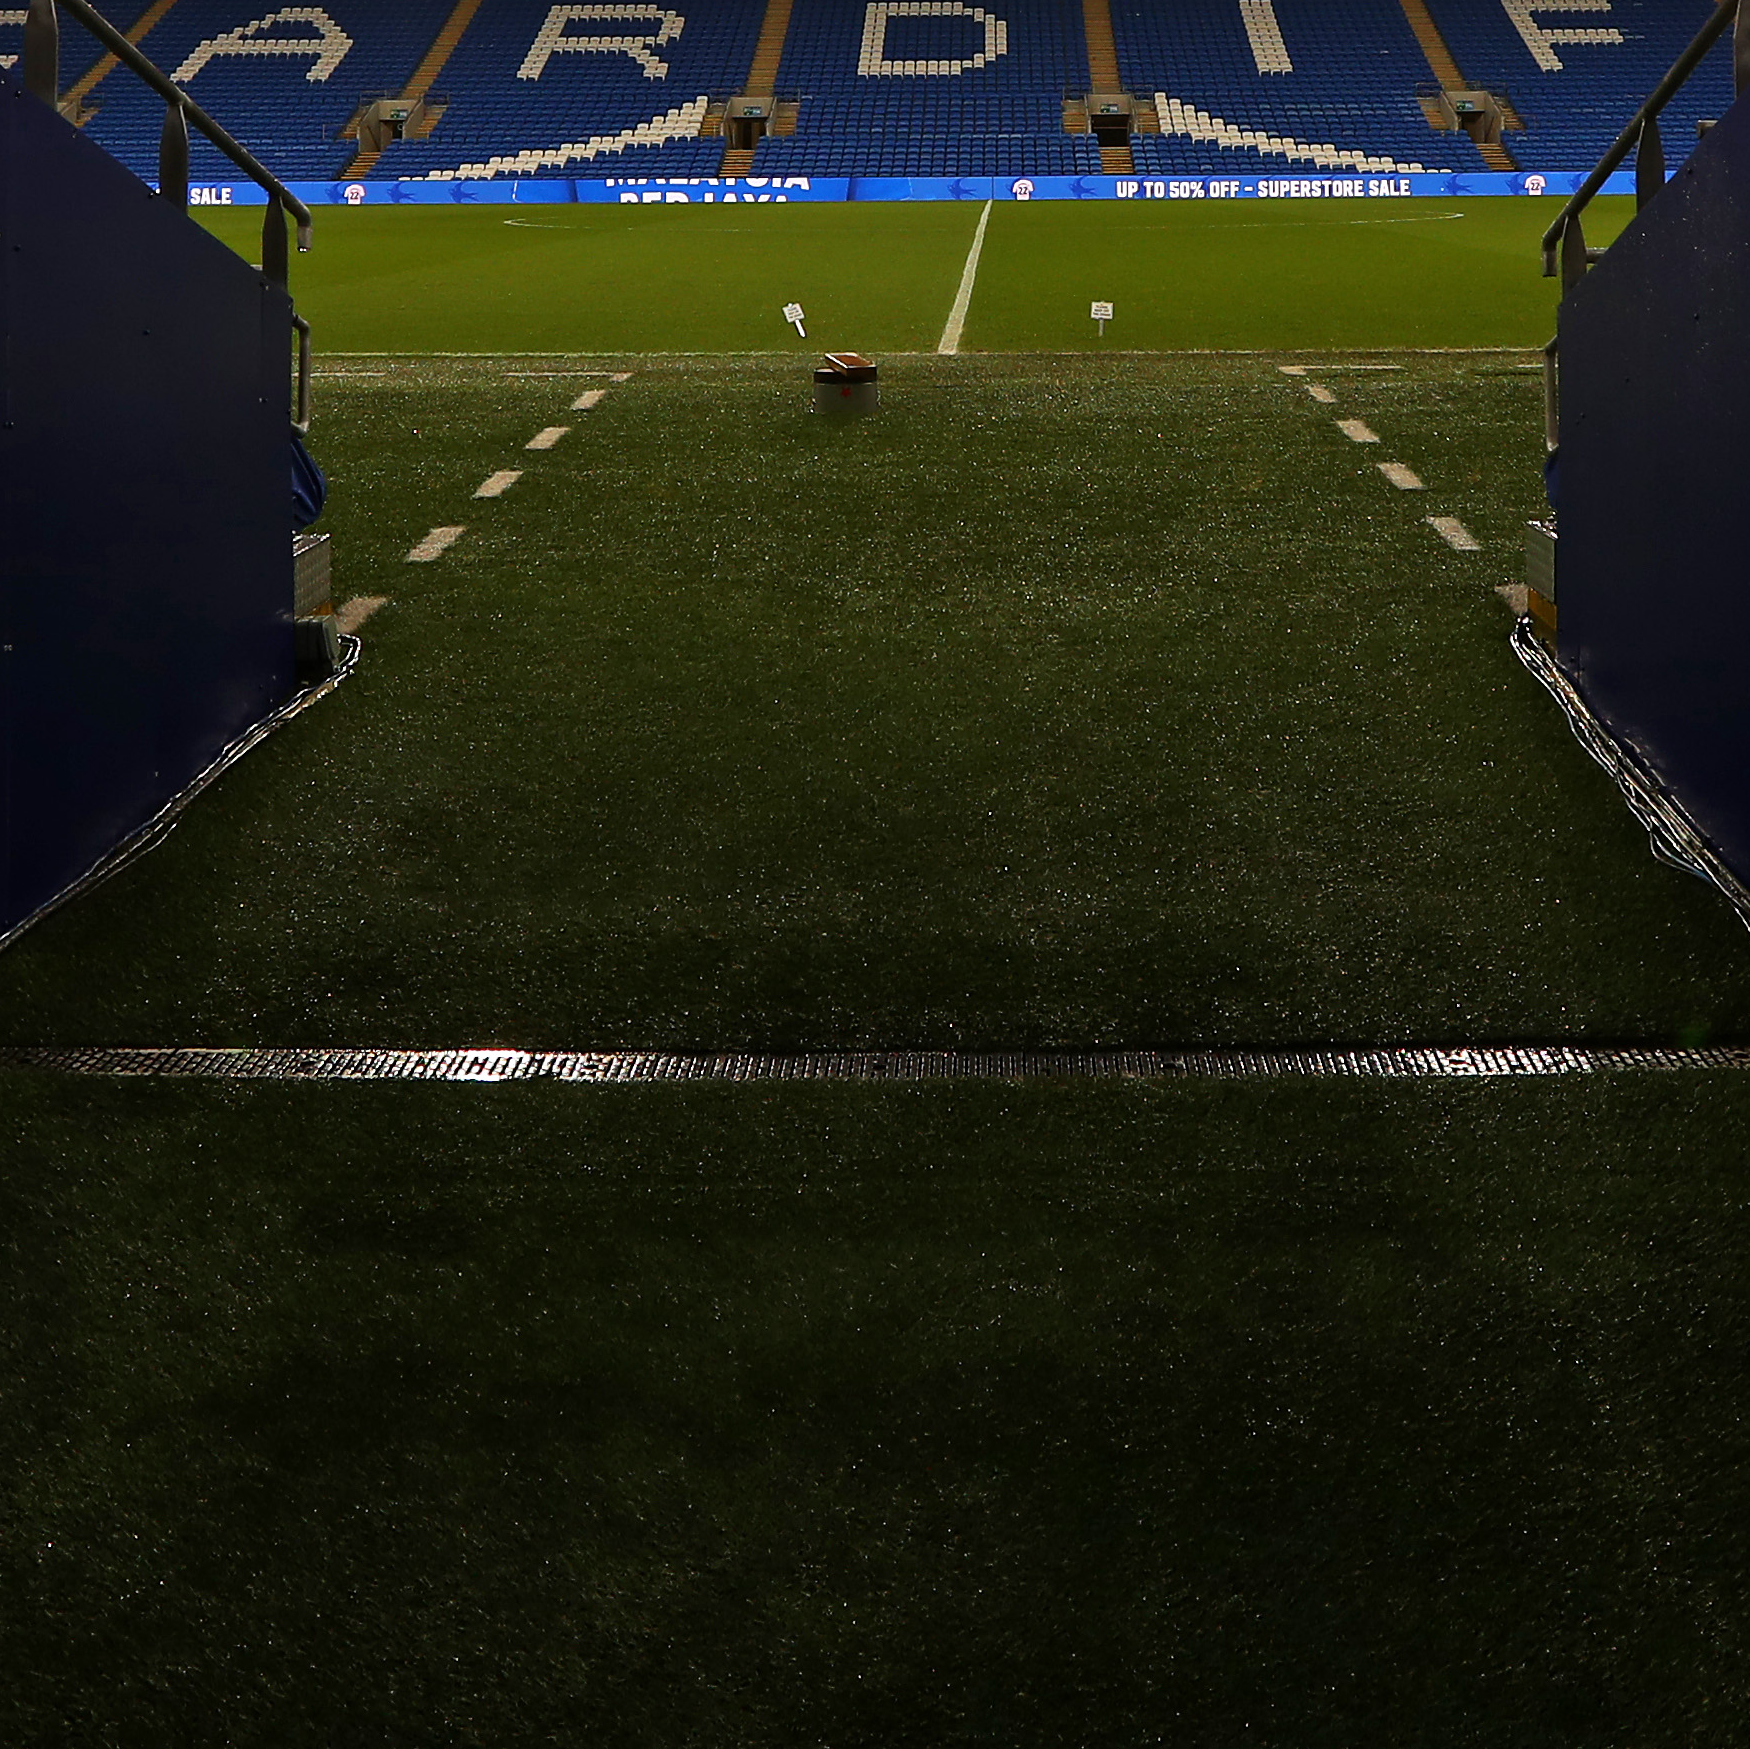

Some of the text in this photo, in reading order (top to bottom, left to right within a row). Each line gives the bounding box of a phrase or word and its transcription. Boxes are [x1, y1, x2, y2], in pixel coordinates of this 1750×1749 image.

[190, 187, 232, 205] SALE
[1115, 180, 1138, 198] UP
[1143, 180, 1166, 198] TO
[1169, 180, 1205, 198] 50%
[1209, 180, 1240, 198] OFF
[1257, 179, 1365, 198] SUPERSTORE
[1368, 179, 1411, 197] SALE
